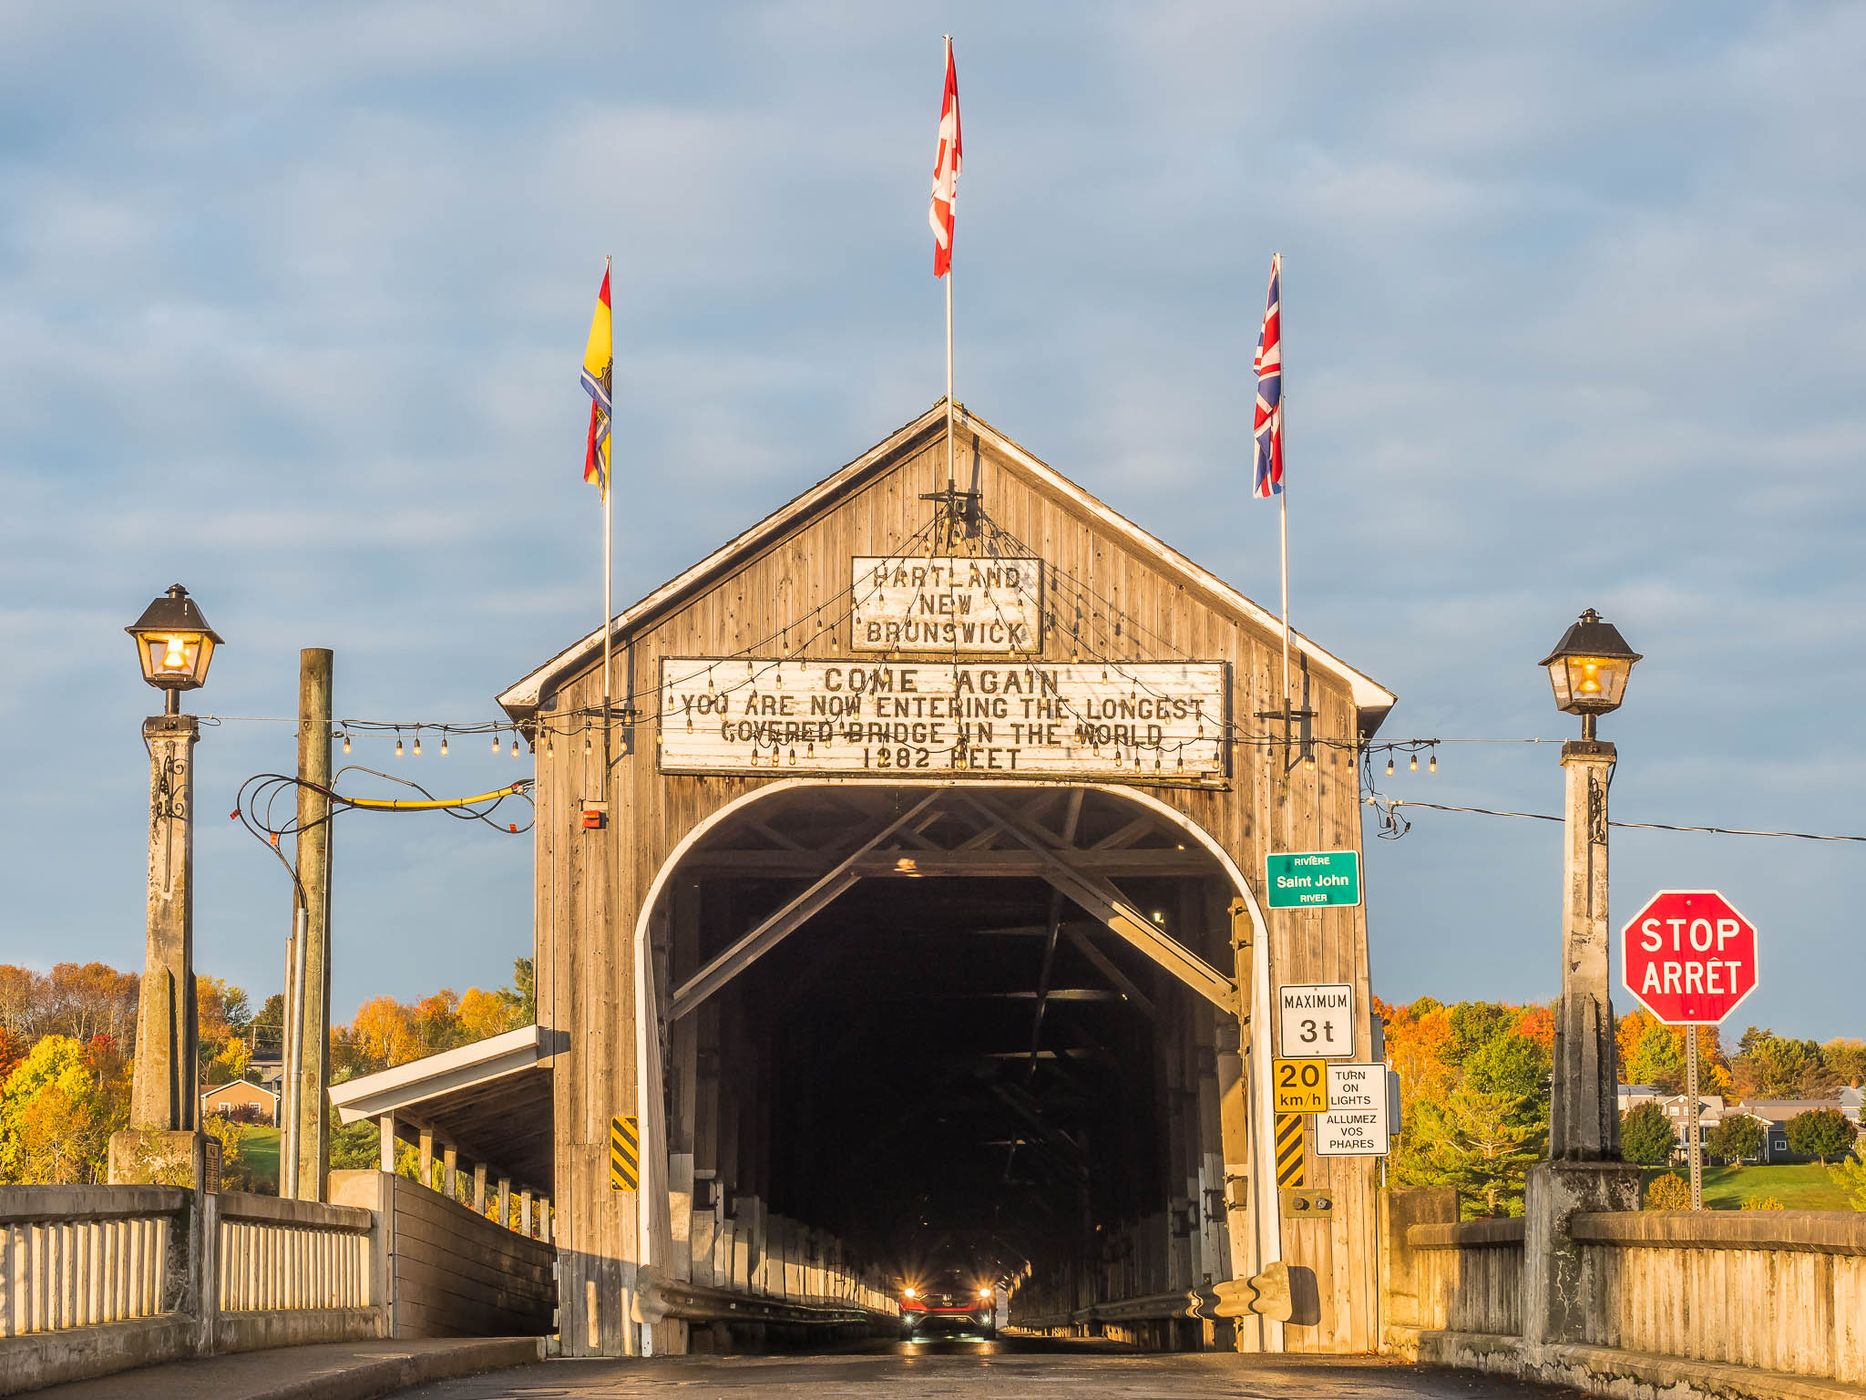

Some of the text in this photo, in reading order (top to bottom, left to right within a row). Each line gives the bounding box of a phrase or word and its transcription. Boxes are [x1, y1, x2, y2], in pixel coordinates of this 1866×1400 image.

[873, 566, 1020, 588] HARTLAND
[920, 594, 972, 615] NEW
[867, 622, 1022, 644] BRUNSWICK
[825, 668, 1058, 693] COME AGAIN
[681, 694, 1204, 720] YOU ARE NOW ENTERING THE LONGEST
[849, 722, 945, 743] BRIDGE
[965, 722, 993, 743] IN
[1010, 724, 1062, 745] THE
[1078, 724, 1163, 745] WORLD
[864, 748, 930, 768] 1282
[1277, 874, 1350, 888] Saint John
[1300, 894, 1328, 903] RIVER
[1640, 918, 1741, 952] STOP
[1641, 957, 1742, 994] ARRÊT
[1284, 994, 1347, 1008] MAXIMUM
[1300, 1019, 1334, 1043] 3 t
[1280, 1065, 1320, 1087] 20
[1336, 1071, 1366, 1080] TURN
[1342, 1083, 1359, 1093] ON
[1280, 1092, 1321, 1107] km/h
[1330, 1096, 1371, 1105] LIGHTS
[1326, 1115, 1377, 1124] ALLUMEZ
[1341, 1127, 1363, 1137] VOS
[1329, 1140, 1375, 1149] PHARES
